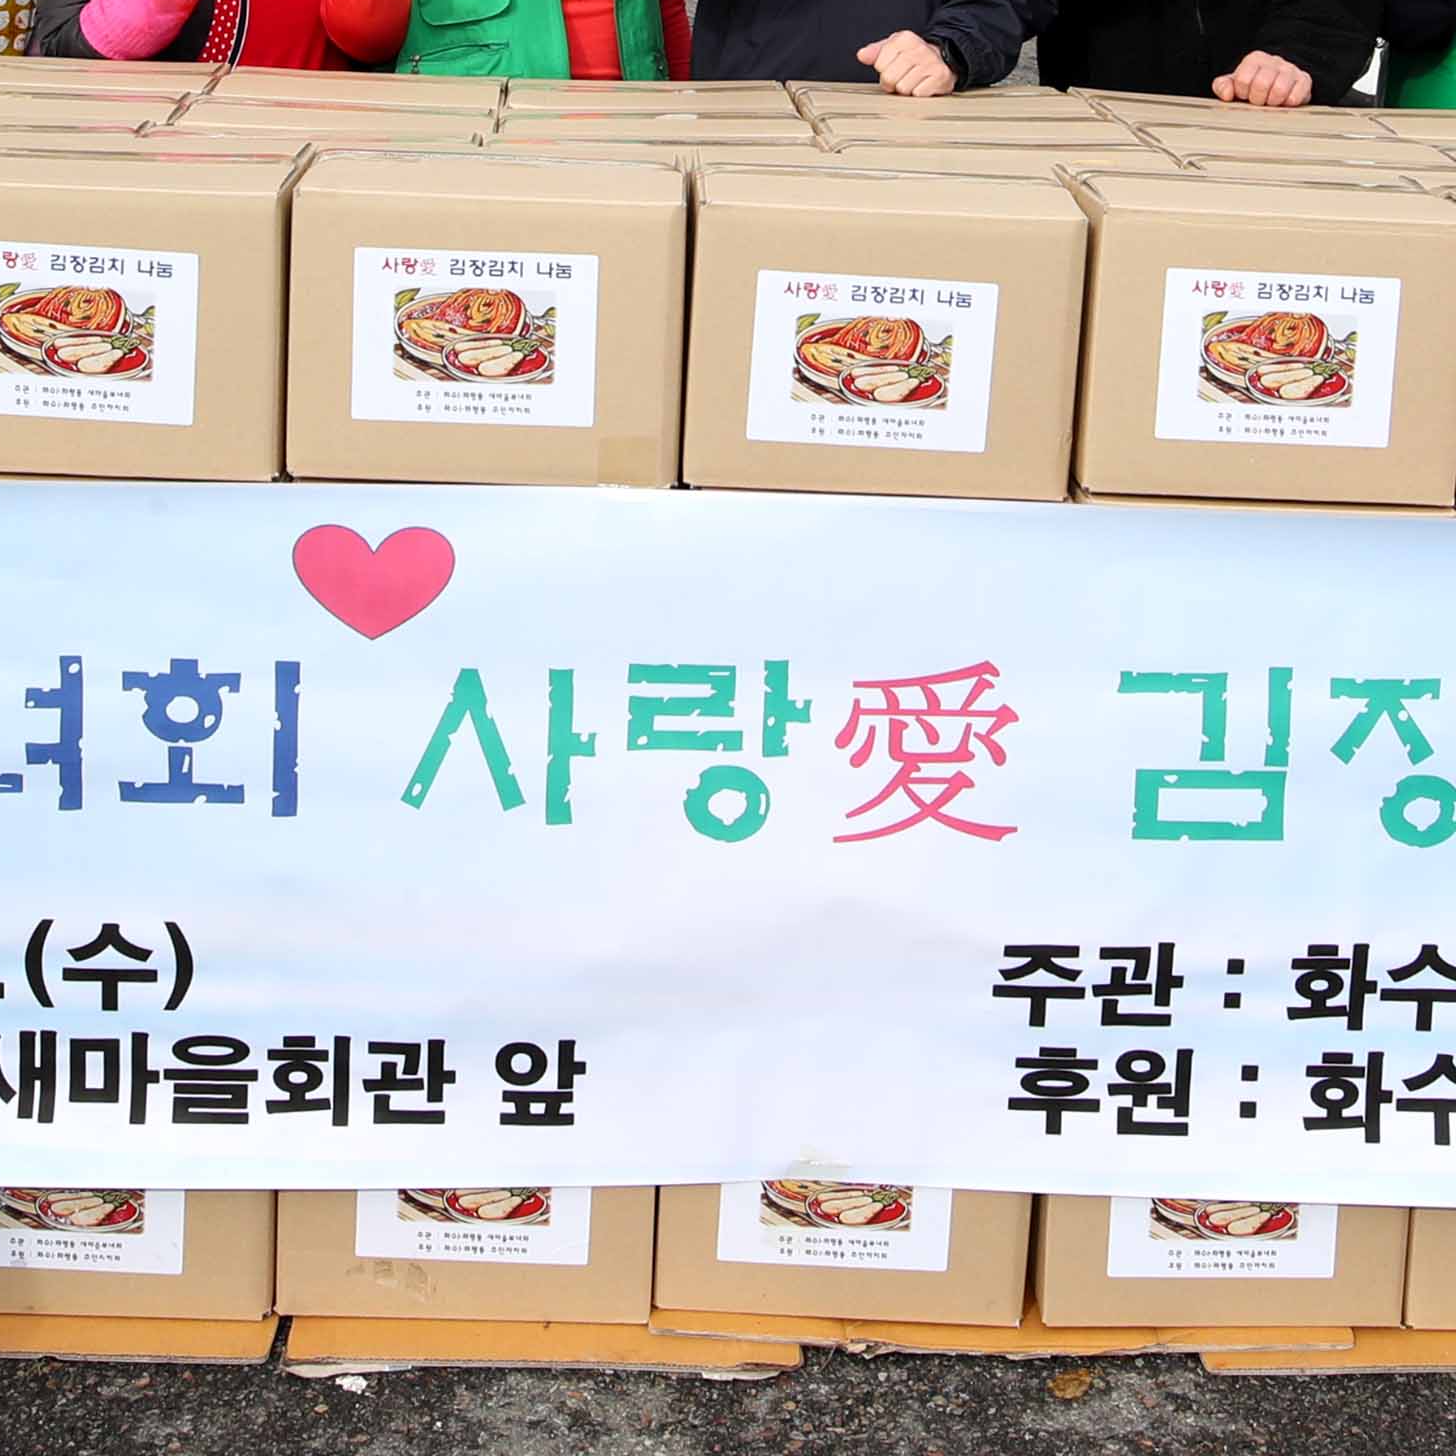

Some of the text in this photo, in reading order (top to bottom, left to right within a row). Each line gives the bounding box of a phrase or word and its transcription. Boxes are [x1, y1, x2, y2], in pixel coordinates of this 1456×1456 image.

[50, 254, 125, 276] 김장김치
[137, 259, 173, 279] 나눔
[449, 258, 524, 278] 김장김치
[536, 261, 572, 279] 나눔
[1257, 282, 1329, 303] 김장김치
[1340, 287, 1375, 305] 나눔
[851, 284, 925, 305] 김장김치
[936, 290, 972, 309] 나눔
[403, 661, 1018, 841] 사랑愛
[993, 943, 1183, 1027] 주관
[496, 1040, 586, 1125] 앞
[1008, 1048, 1193, 1136] 후원
